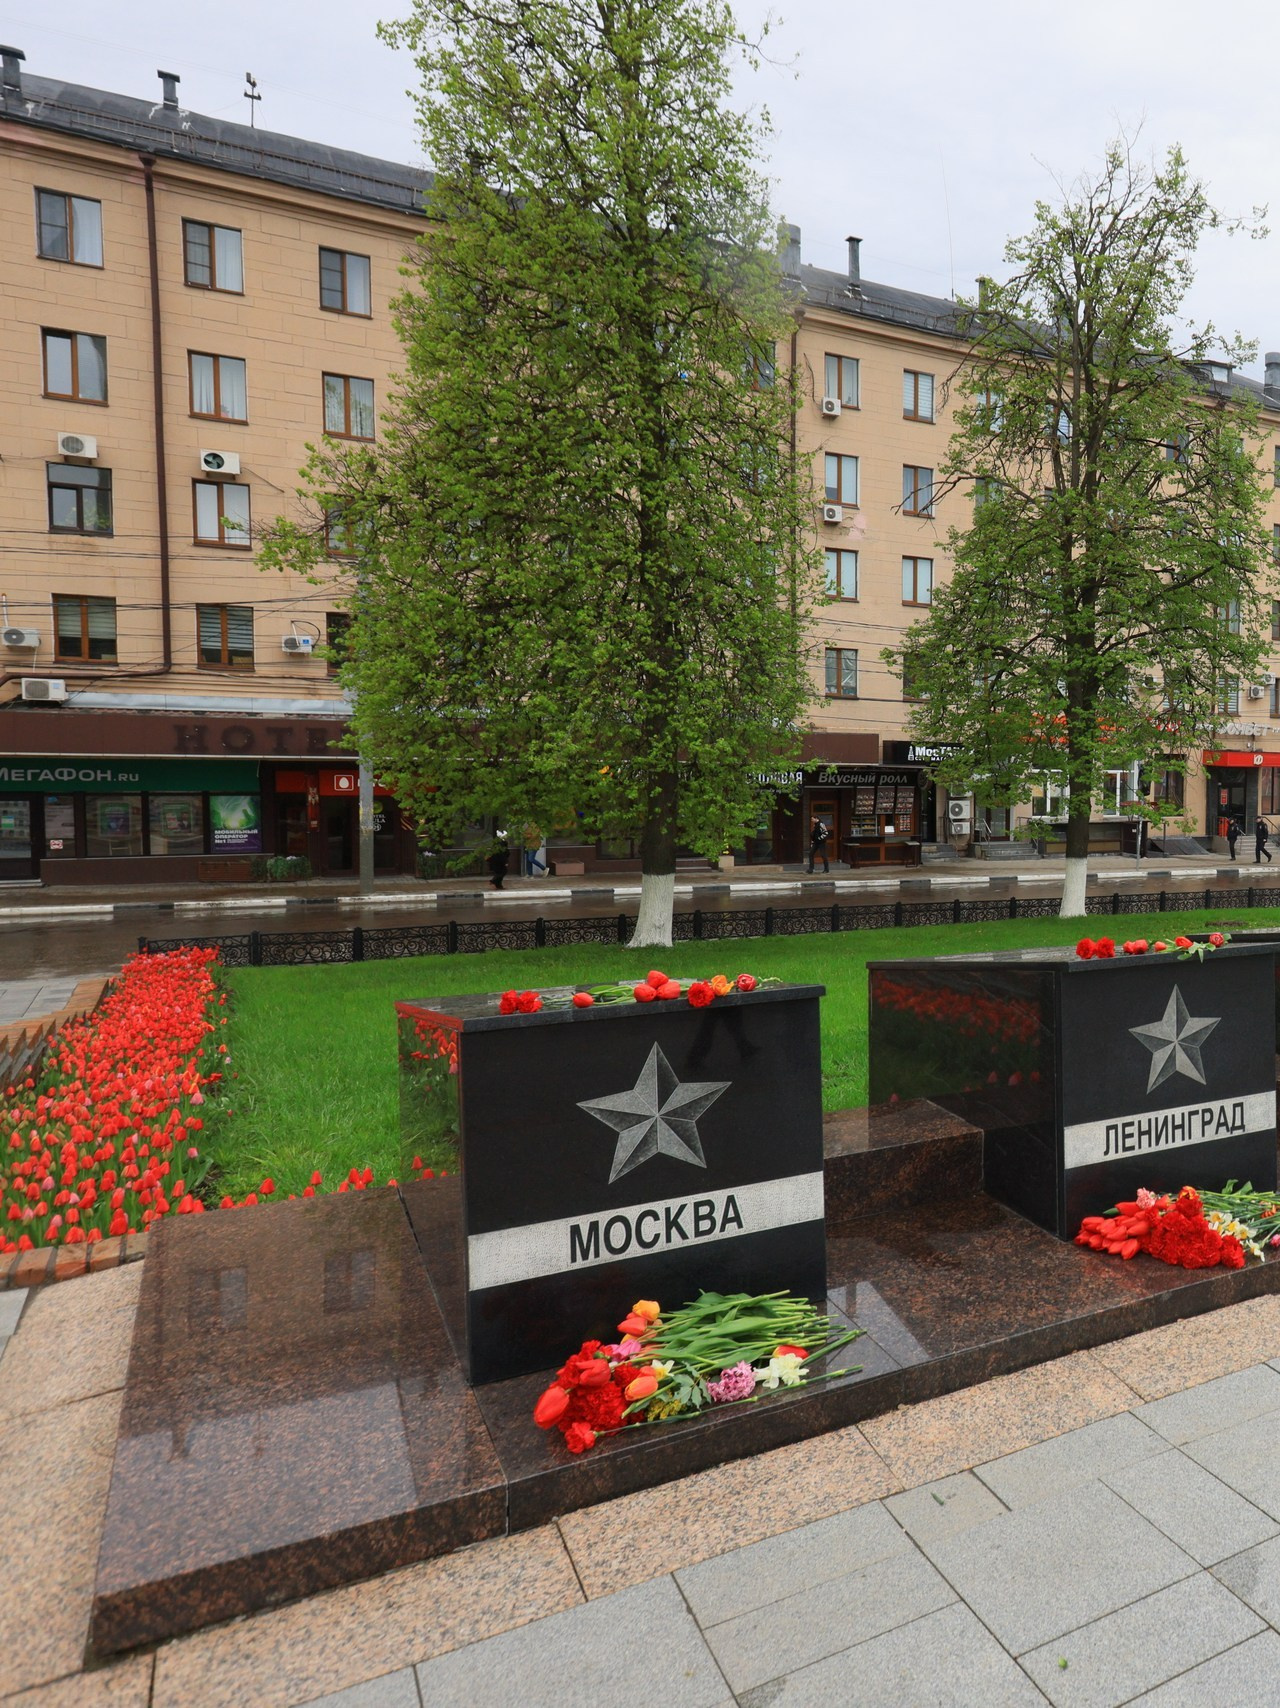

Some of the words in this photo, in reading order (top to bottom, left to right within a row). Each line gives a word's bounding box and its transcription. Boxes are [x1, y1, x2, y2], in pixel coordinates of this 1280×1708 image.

[818, 771, 876, 786] Вкусный
[879, 774, 908, 787] ролл
[1102, 1101, 1246, 1157] ЛЕНИНГРАД
[569, 1194, 745, 1265] МОСКВА
